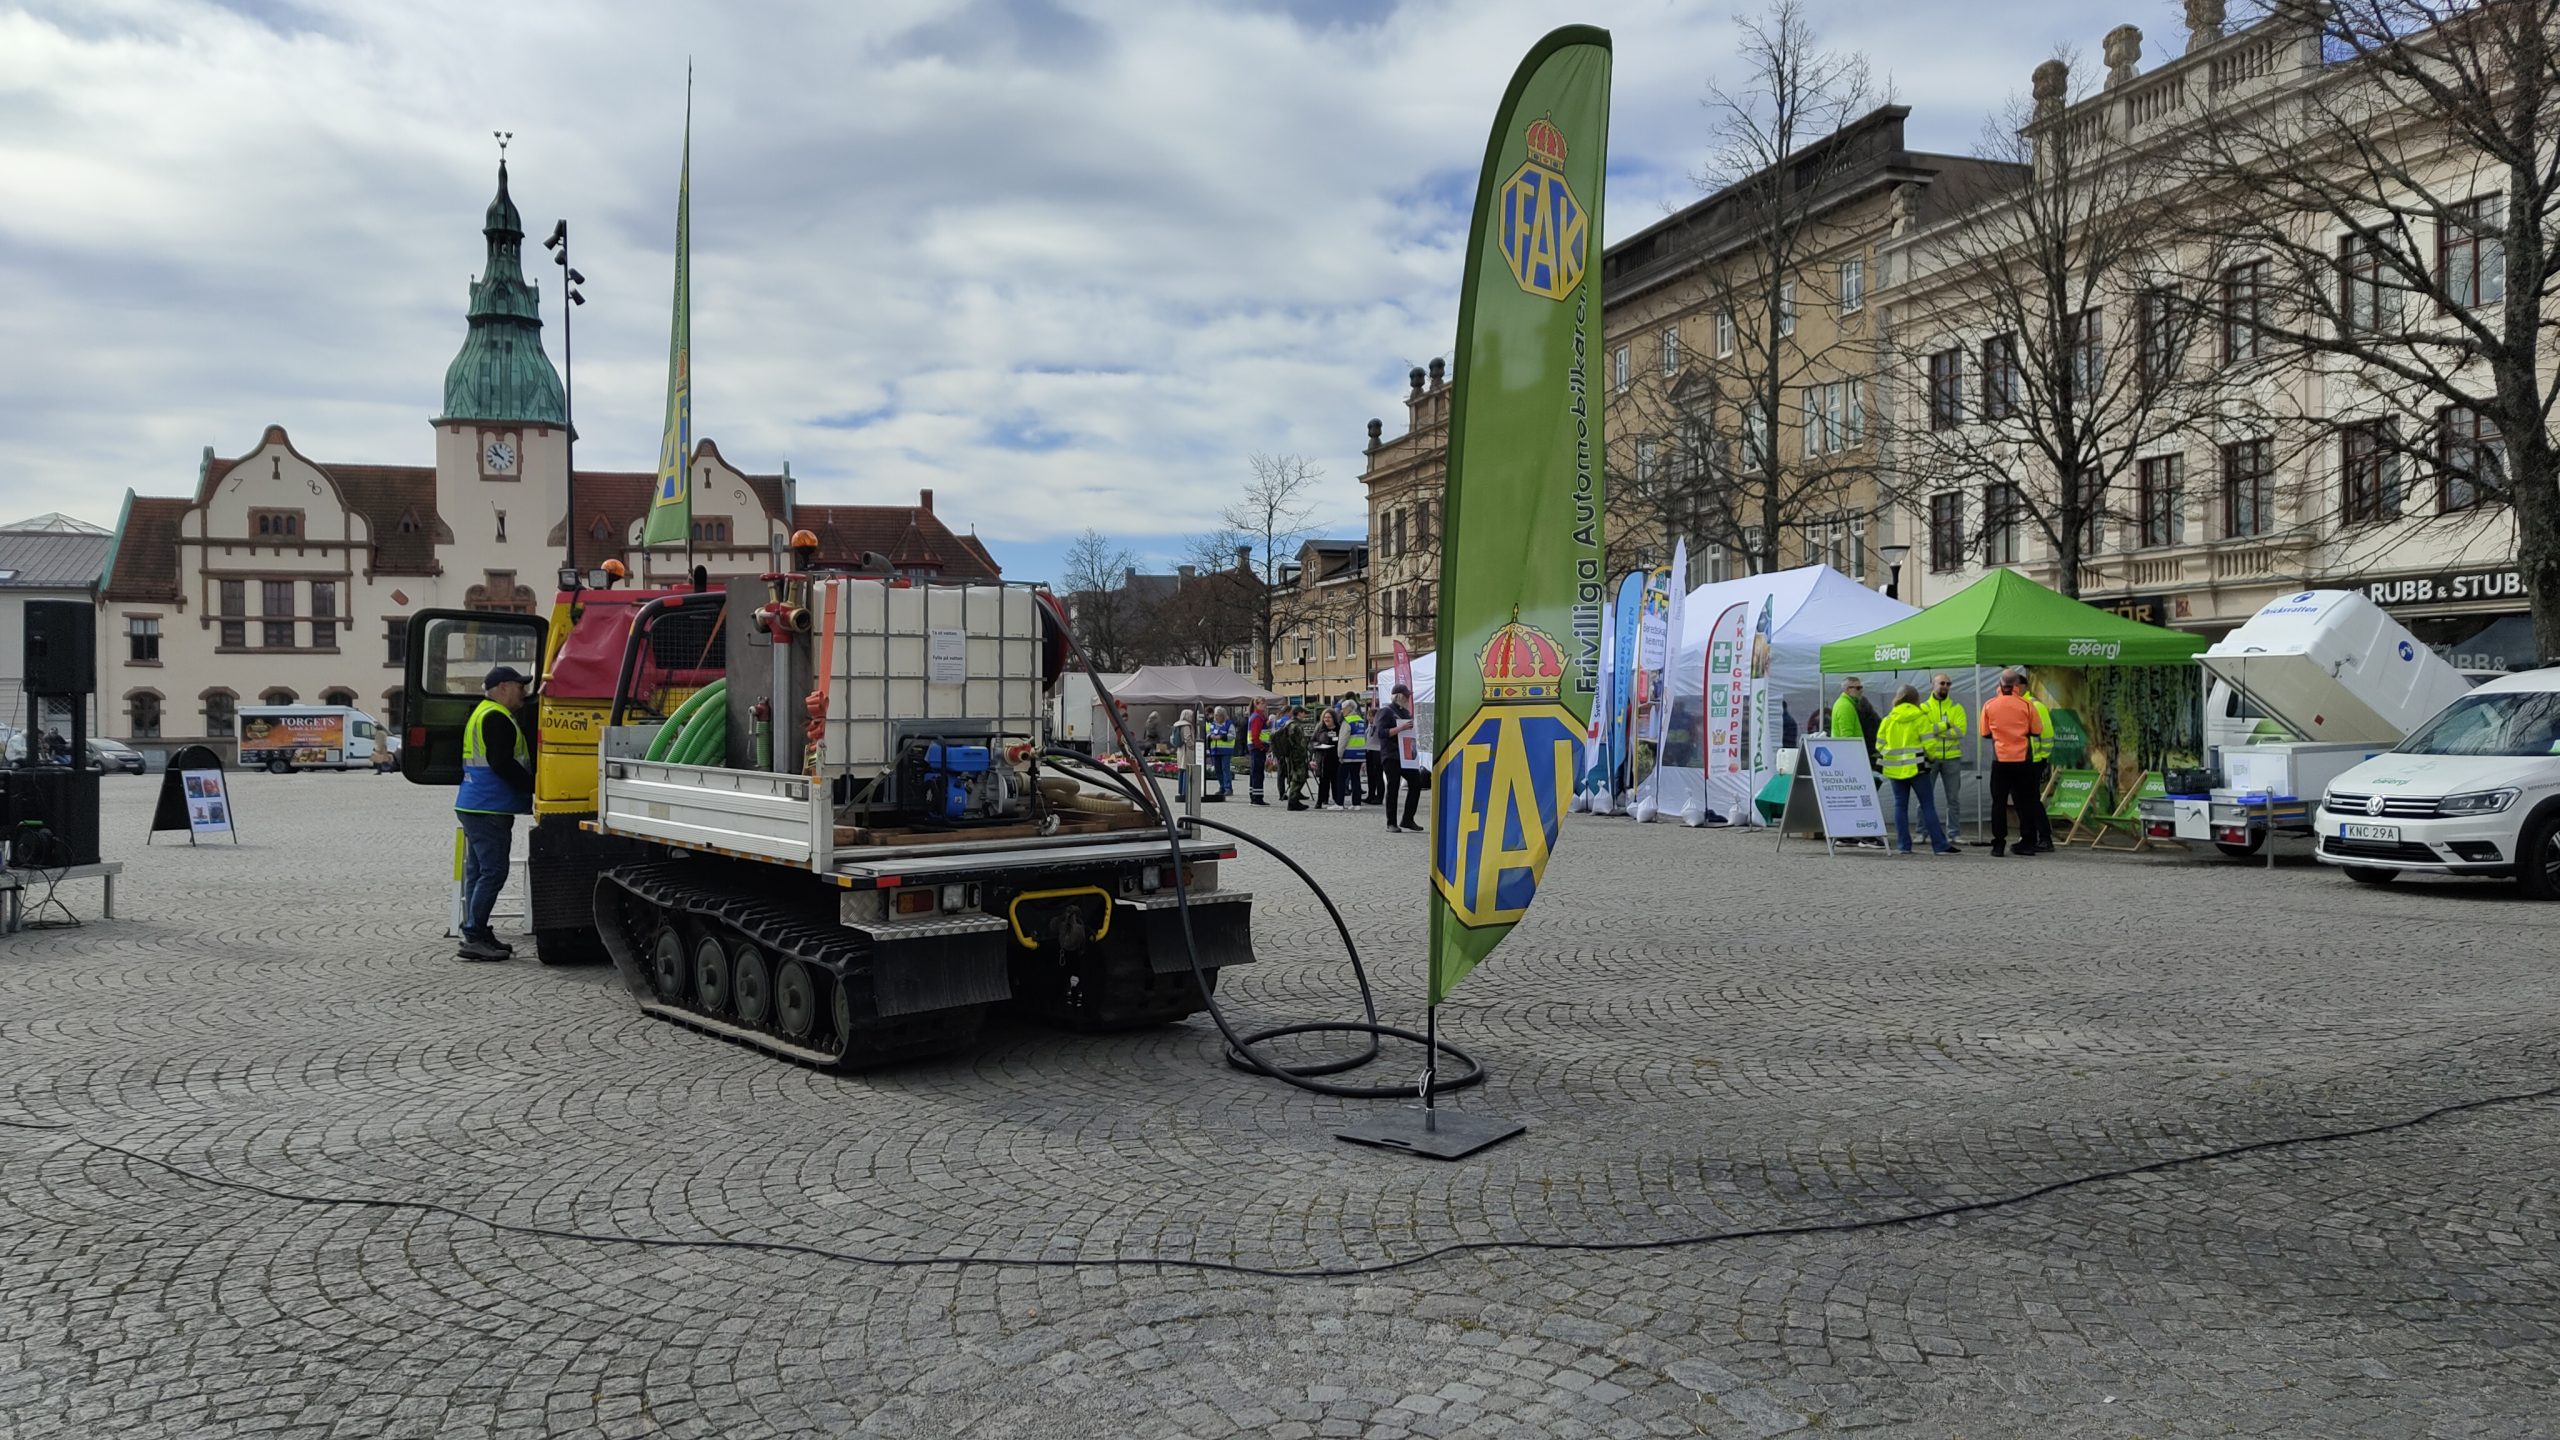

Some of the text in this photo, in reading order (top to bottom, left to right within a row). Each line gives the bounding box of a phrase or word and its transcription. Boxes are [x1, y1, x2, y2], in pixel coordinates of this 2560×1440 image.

[1508, 168, 1586, 298] FAK
[1572, 558, 1602, 694] Frivilliga
[2371, 572, 2529, 603] RUBB & STUB
[280, 717, 335, 727] TORGETS
[1728, 614, 1745, 758] AKUTGRUPPEN
[2350, 827, 2394, 839] KNC 29A
